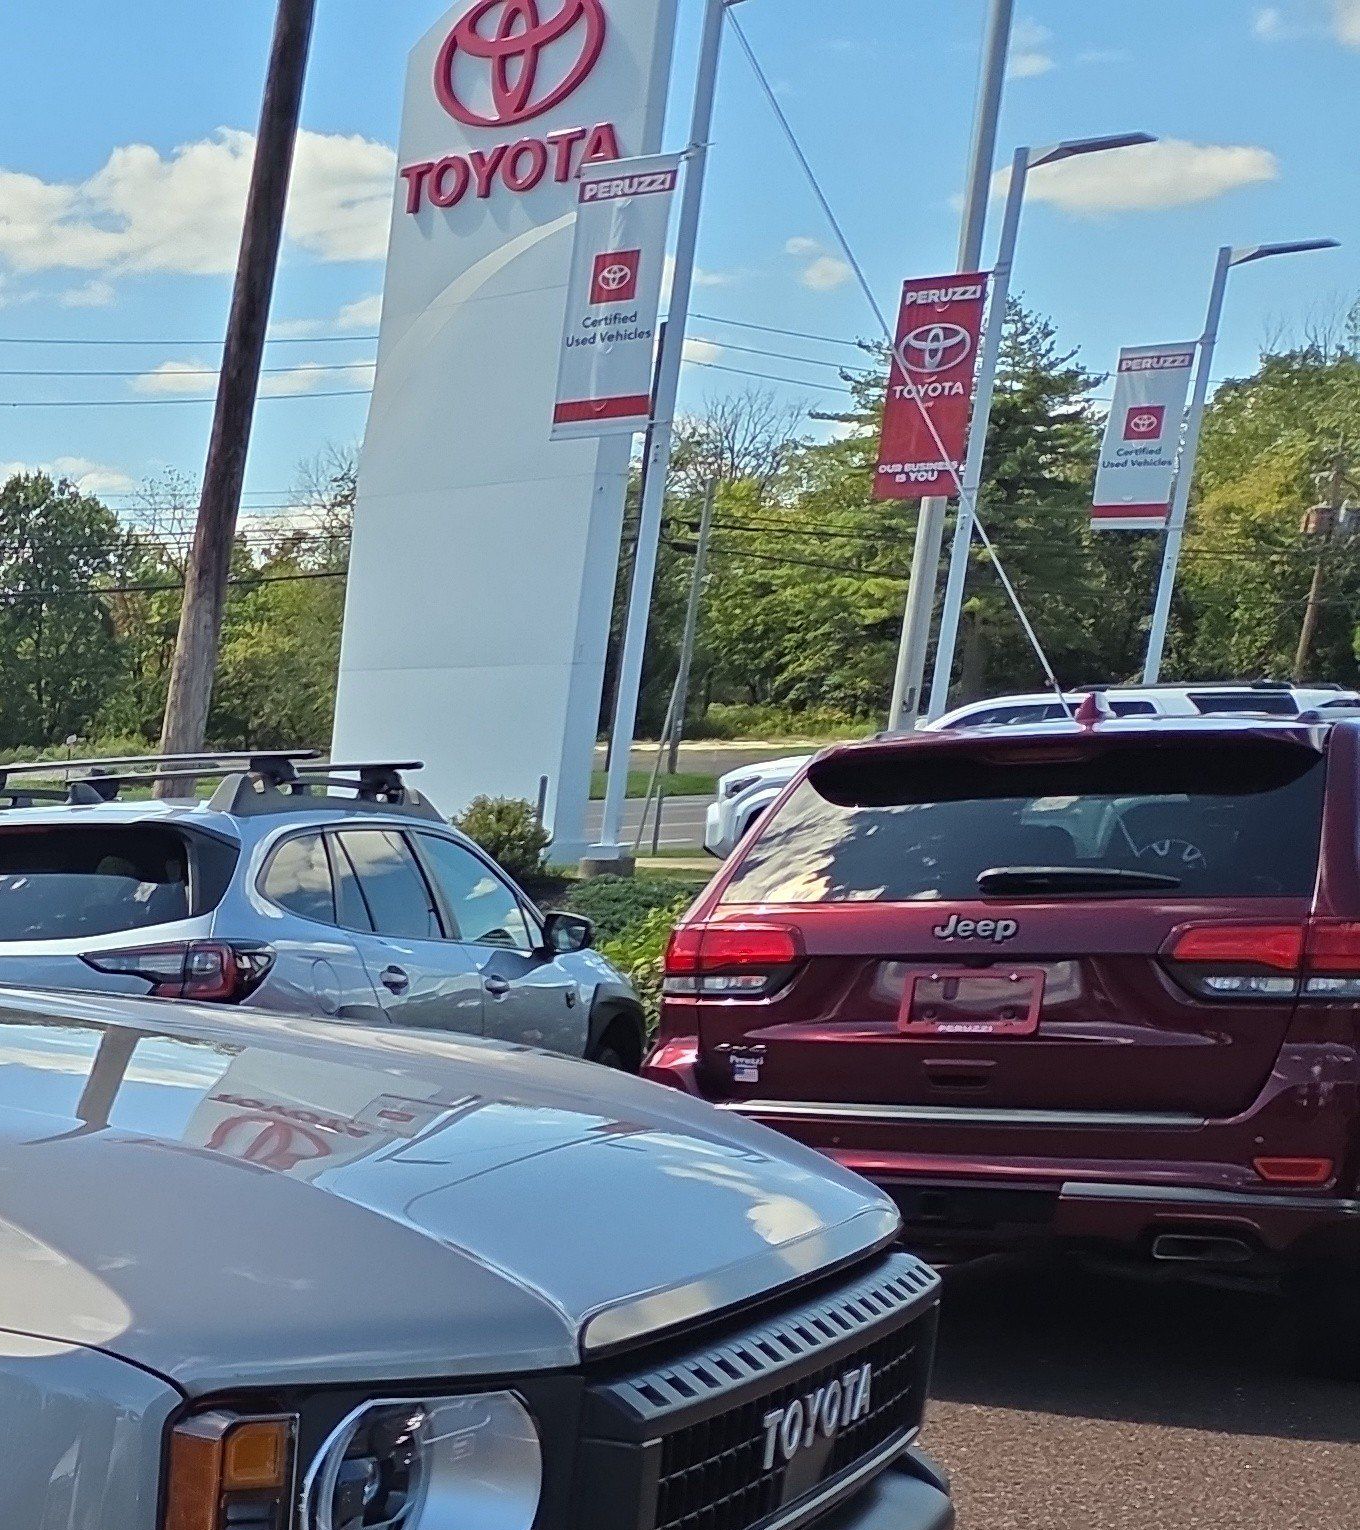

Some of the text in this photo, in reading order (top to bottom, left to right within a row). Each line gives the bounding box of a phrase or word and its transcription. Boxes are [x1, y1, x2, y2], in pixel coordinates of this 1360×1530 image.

[400, 122, 619, 214] TOYOTA
[583, 172, 672, 201] PERUZZI
[905, 284, 982, 305] PERUZZI
[582, 310, 638, 328] Certified
[565, 327, 651, 347] Used Vehicles
[1121, 355, 1190, 371] PERUZZI
[892, 381, 964, 400] TOYOTA
[1116, 446, 1162, 457] Certified
[1102, 459, 1173, 468] Used Vehicles
[909, 471, 939, 482] YOU
[933, 913, 1018, 941] Jeep
[761, 1362, 872, 1470] TOYOTA
